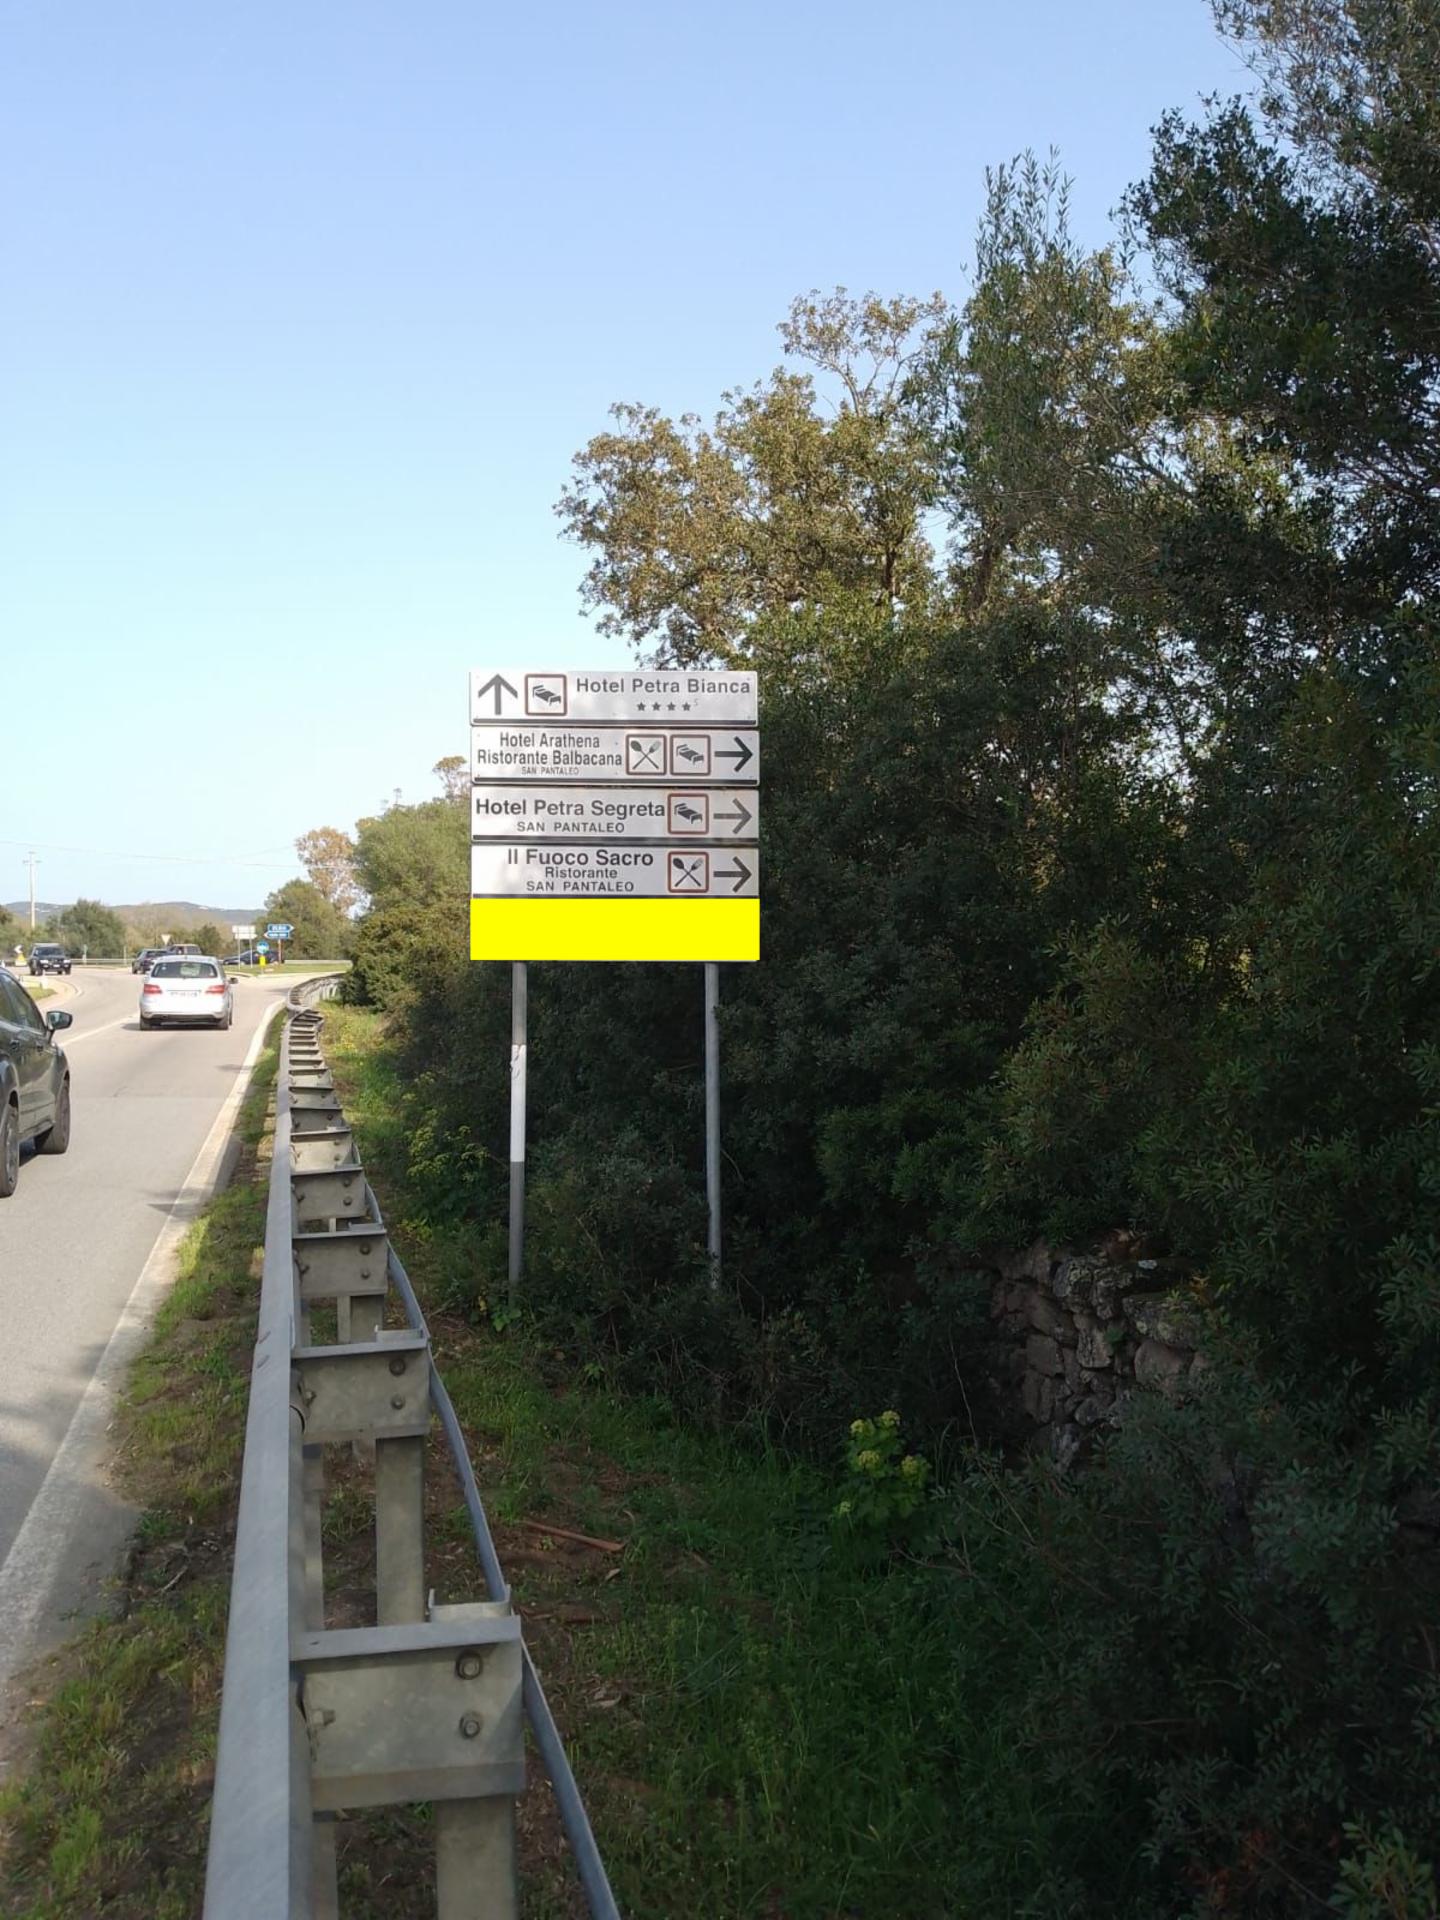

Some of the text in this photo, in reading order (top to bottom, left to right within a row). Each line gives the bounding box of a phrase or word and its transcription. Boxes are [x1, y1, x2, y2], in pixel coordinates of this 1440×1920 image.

[576, 678, 750, 693] Hotel Petra Bianca
[500, 732, 600, 748] Hotel Arathena
[477, 749, 622, 766] Ristorante Balbacana
[521, 766, 579, 776] SAN PANTALEO
[476, 798, 665, 820] Hotel Petra Segreta
[517, 821, 625, 833] SAN PANTALEO
[526, 849, 589, 865] Fuoco
[596, 849, 654, 866] Sacro
[545, 867, 618, 879] Ristorante
[526, 880, 634, 892] SAN PANTALEO
